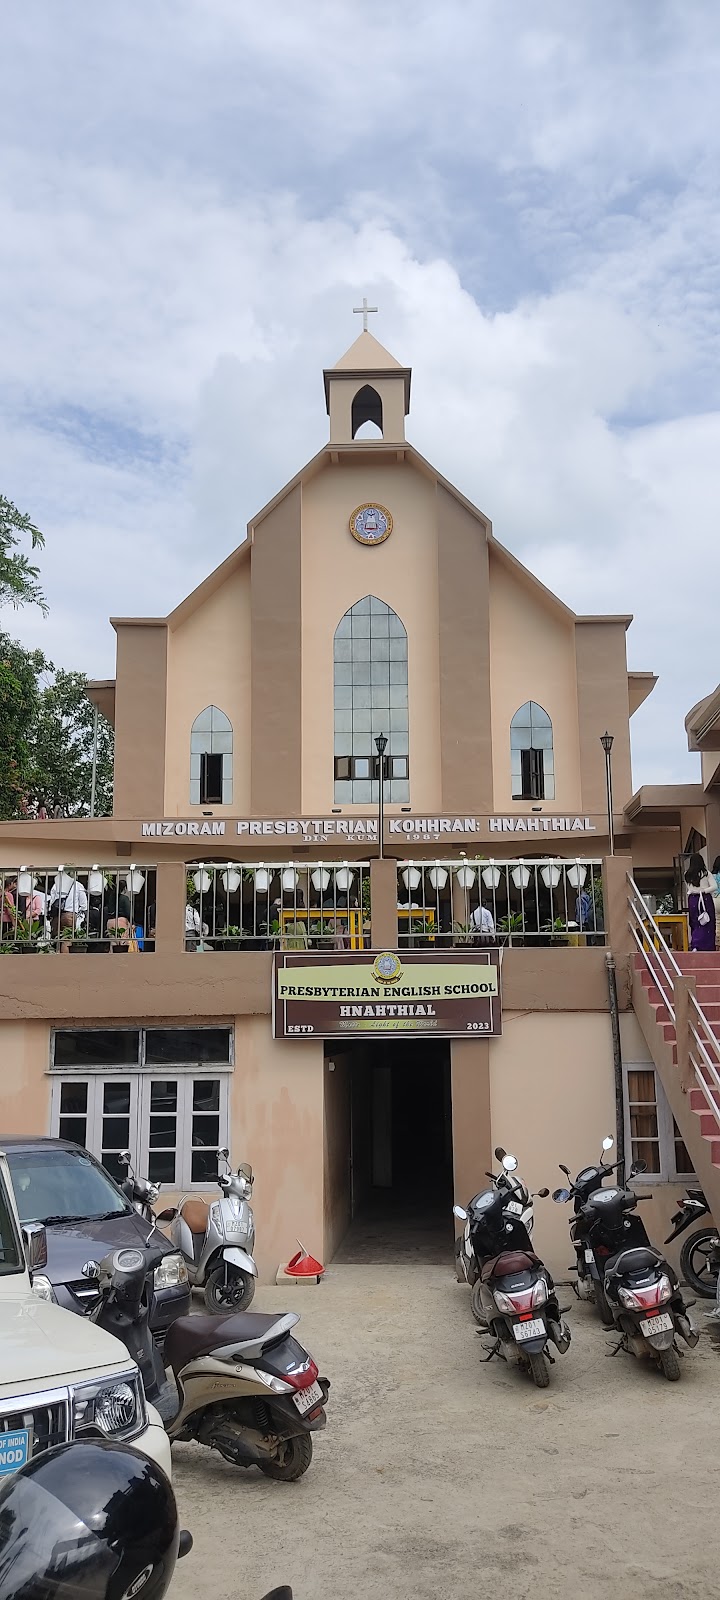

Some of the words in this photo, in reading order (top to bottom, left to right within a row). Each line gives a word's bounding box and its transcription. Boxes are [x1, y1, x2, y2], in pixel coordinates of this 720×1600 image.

[142, 821, 226, 836] MIZORAM
[236, 819, 378, 835] PRESBYTERIAN
[389, 818, 480, 833] KOHHRAN:
[489, 817, 596, 832] HNAHTHIAL
[302, 834, 329, 842] DIN
[345, 834, 378, 842] KUM
[405, 833, 441, 841] 1987
[280, 985, 381, 997] PRESBYTERIAN
[383, 985, 441, 997] ENGLISH
[444, 982, 496, 995] SCHOOL
[339, 1004, 436, 1017] HNAHTHIAL
[287, 1025, 314, 1033] ESTD
[393, 1020, 400, 1028] of
[466, 1022, 490, 1030] 2023
[520, 1321, 537, 1331] MZ01
[8, 1437, 25, 1447] INDIA
